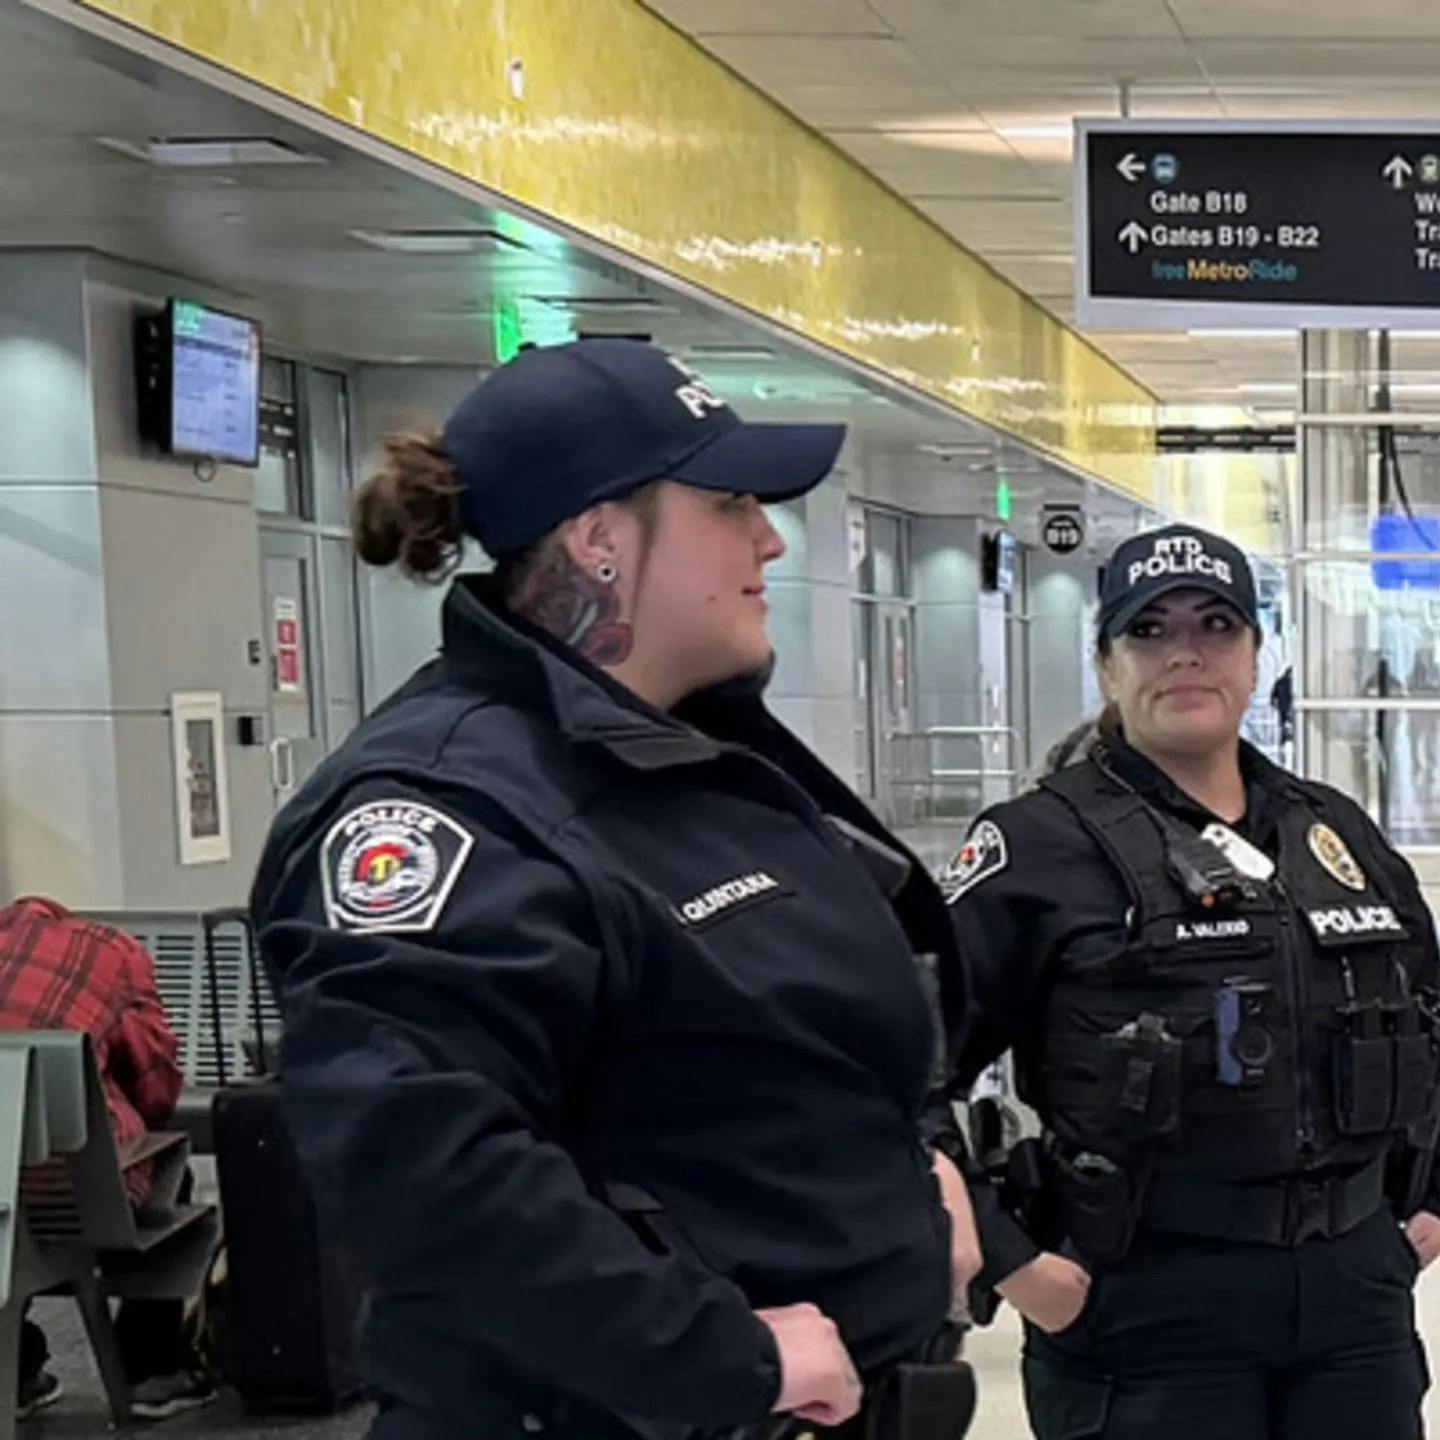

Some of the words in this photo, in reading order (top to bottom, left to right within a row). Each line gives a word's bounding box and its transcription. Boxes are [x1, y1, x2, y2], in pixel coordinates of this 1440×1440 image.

[1151, 191, 1200, 213] Gate
[1205, 191, 1248, 213] B18
[1152, 225, 1213, 246] Gates
[1218, 225, 1259, 246] B19
[1278, 226, 1319, 246] B22
[1155, 537, 1203, 557] RTD
[1128, 554, 1233, 586] POLICE
[344, 808, 437, 836] POLICE
[682, 870, 779, 921] QUINTANA
[1308, 905, 1402, 935] POLICE
